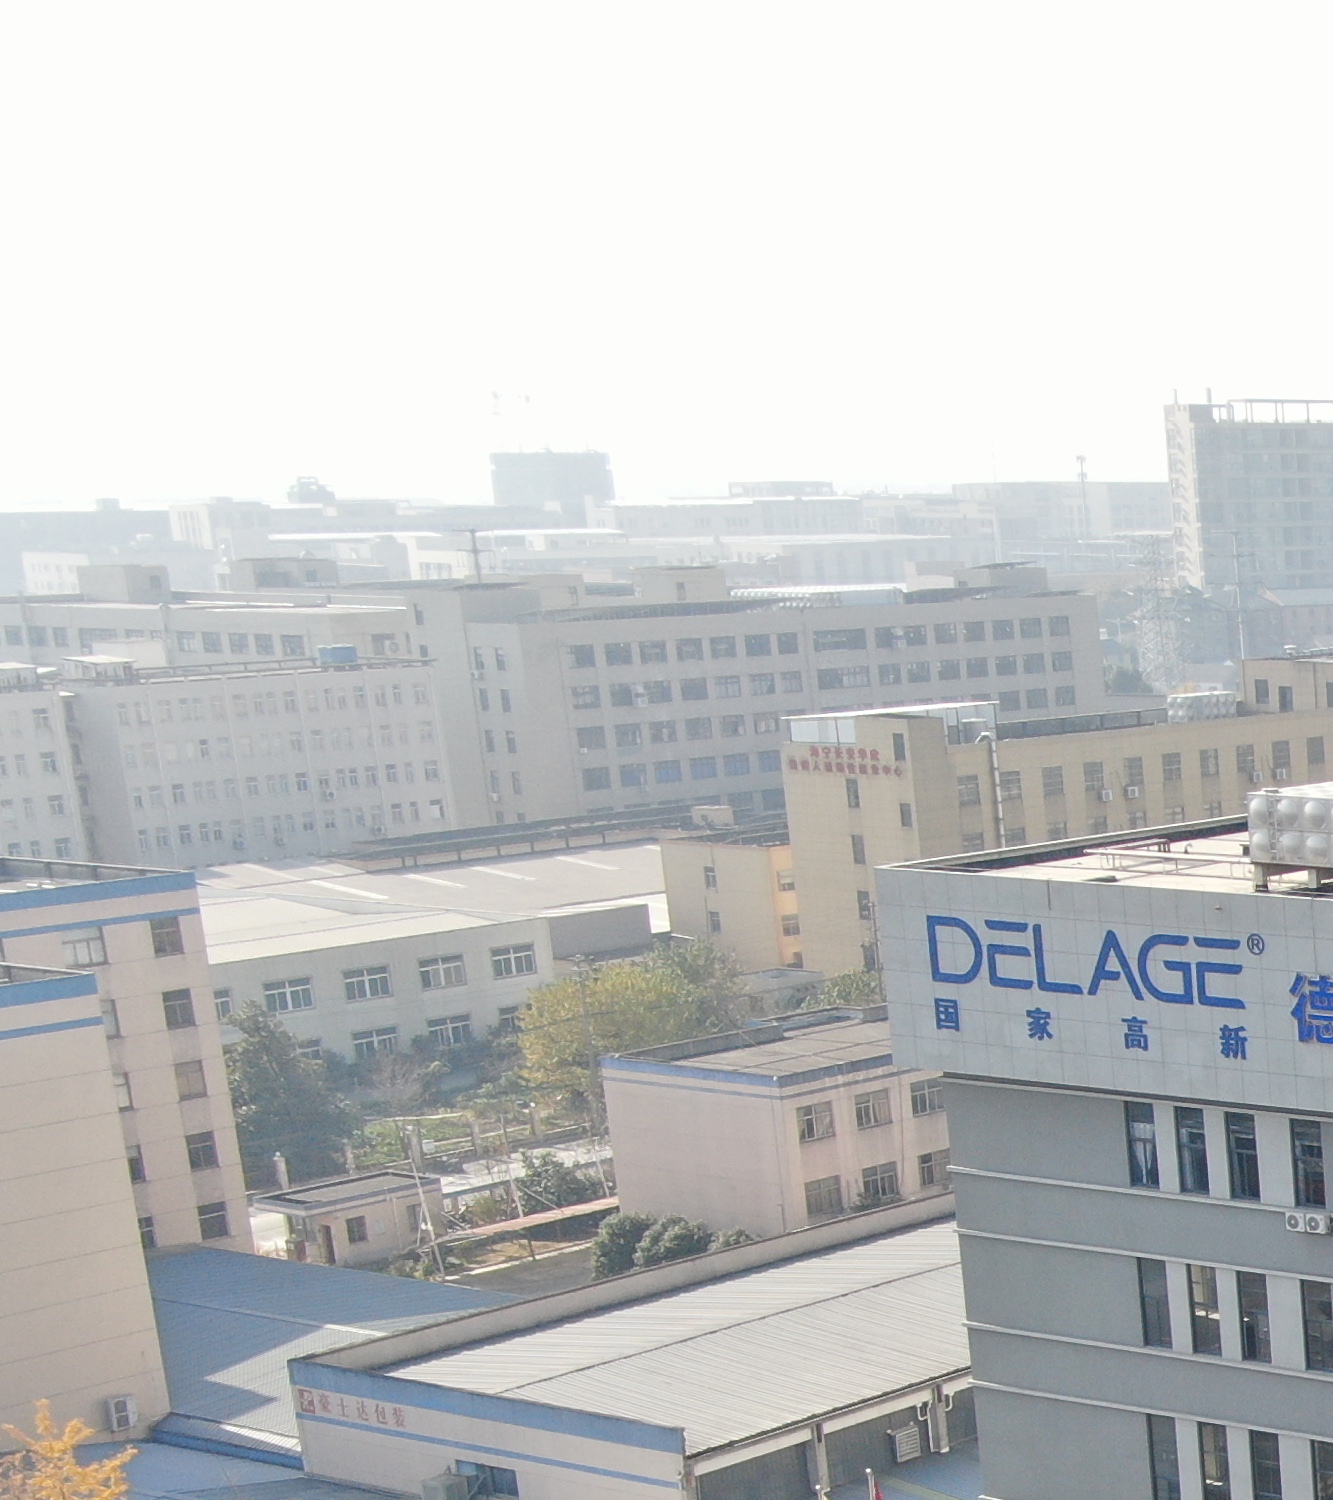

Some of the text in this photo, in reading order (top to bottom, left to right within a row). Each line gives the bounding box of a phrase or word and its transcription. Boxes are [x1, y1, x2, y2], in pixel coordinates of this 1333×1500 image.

[933, 996, 1249, 1062] 国家高新
[318, 1392, 407, 1429] 豪士达包装
